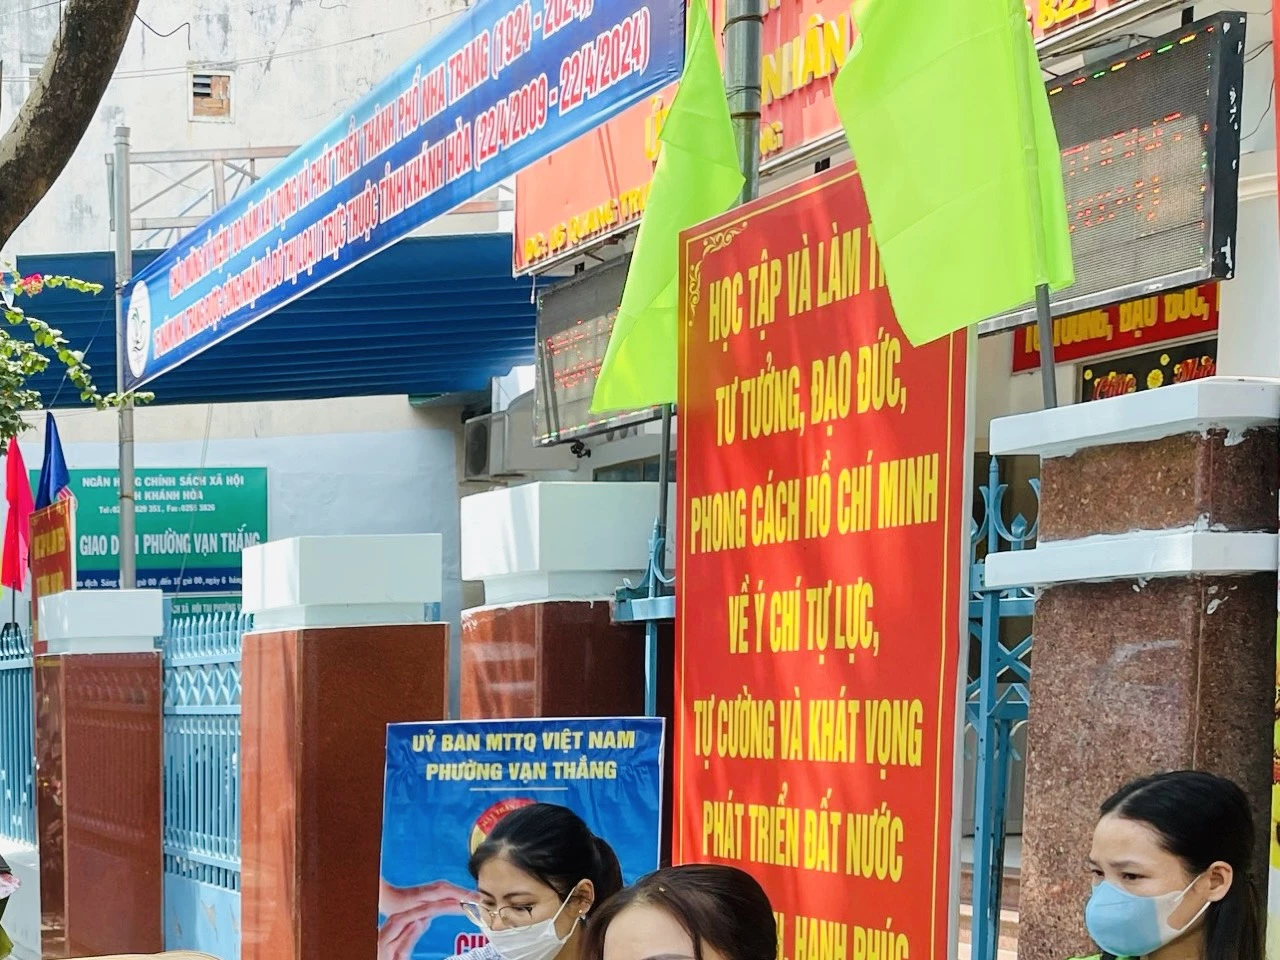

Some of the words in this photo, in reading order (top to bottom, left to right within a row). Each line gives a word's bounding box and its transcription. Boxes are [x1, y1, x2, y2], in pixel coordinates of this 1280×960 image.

[761, 14, 847, 106] NHÂN
[241, 257, 261, 309] NHẬN
[283, 237, 298, 285] THỊ
[297, 225, 318, 276] LOẠI
[322, 203, 346, 260] TRỰC
[346, 178, 379, 242] THUỘC
[379, 161, 404, 224] TỈNH
[404, 141, 446, 209] KHÁNH
[446, 117, 472, 184] HÒA
[473, 73, 548, 172] (22/4/2009
[559, 6, 651, 117] 22/4/2024)
[275, 174, 297, 231] DỰNG
[297, 159, 310, 211] VÀ
[310, 143, 335, 202] PHÁT
[334, 114, 361, 187] TRIỂN
[362, 104, 396, 166] THÀNH
[397, 65, 421, 143] PHỐ
[420, 62, 447, 127] NHA
[448, 28, 490, 107] TRANG
[492, 1, 532, 80] (1924
[568, 198, 619, 245] QUANG
[708, 271, 743, 352] HỌC
[748, 249, 782, 341] TẬP
[787, 232, 811, 317] VÀ
[817, 222, 862, 307] LÀM
[715, 377, 740, 447] TƯ
[741, 352, 805, 440] TƯỞNG,
[811, 349, 851, 437] ĐẠO
[857, 328, 907, 413] ĐỨC,
[82, 475, 111, 488] NGÂN
[113, 477, 142, 488] HG
[144, 474, 176, 487] CHÍNH
[179, 473, 207, 486] SÁCH
[209, 473, 223, 486] XÃ
[226, 473, 245, 488] HỘI
[144, 489, 180, 501] KHÁNH
[183, 488, 203, 500] HÒA
[690, 487, 746, 554] PHONG
[751, 470, 801, 547] CÁCH
[805, 451, 833, 539] HỒ
[836, 450, 873, 536] CHÍ
[877, 453, 939, 529] MINH
[80, 535, 108, 556] GIAO
[143, 527, 191, 554] PHƯỜNG
[194, 532, 217, 557] VẠN
[220, 523, 261, 553] THẮNG
[728, 574, 750, 655] VỀ
[753, 579, 766, 653] Ý
[769, 576, 803, 653] CHÍ
[805, 579, 833, 664] TỰ
[834, 577, 879, 664] LỰC,
[425, 757, 503, 781] PHƯỜNG
[507, 762, 549, 784] VẠN
[553, 753, 617, 780] THẮNG
[441, 733, 481, 752] BAN
[485, 732, 537, 753] MTTQ
[541, 727, 586, 752] VIỆT
[592, 730, 635, 750] NAM
[694, 694, 716, 770] TỰ
[717, 685, 775, 761] CƯỜNG
[780, 687, 803, 761] VÀ
[808, 686, 860, 765] KHÁT
[865, 698, 923, 780] VỌNG
[702, 790, 745, 861] PHÁT
[748, 782, 799, 870] TRIỂN
[803, 788, 841, 873] ĐẤT
[846, 802, 904, 884] NƯỚC
